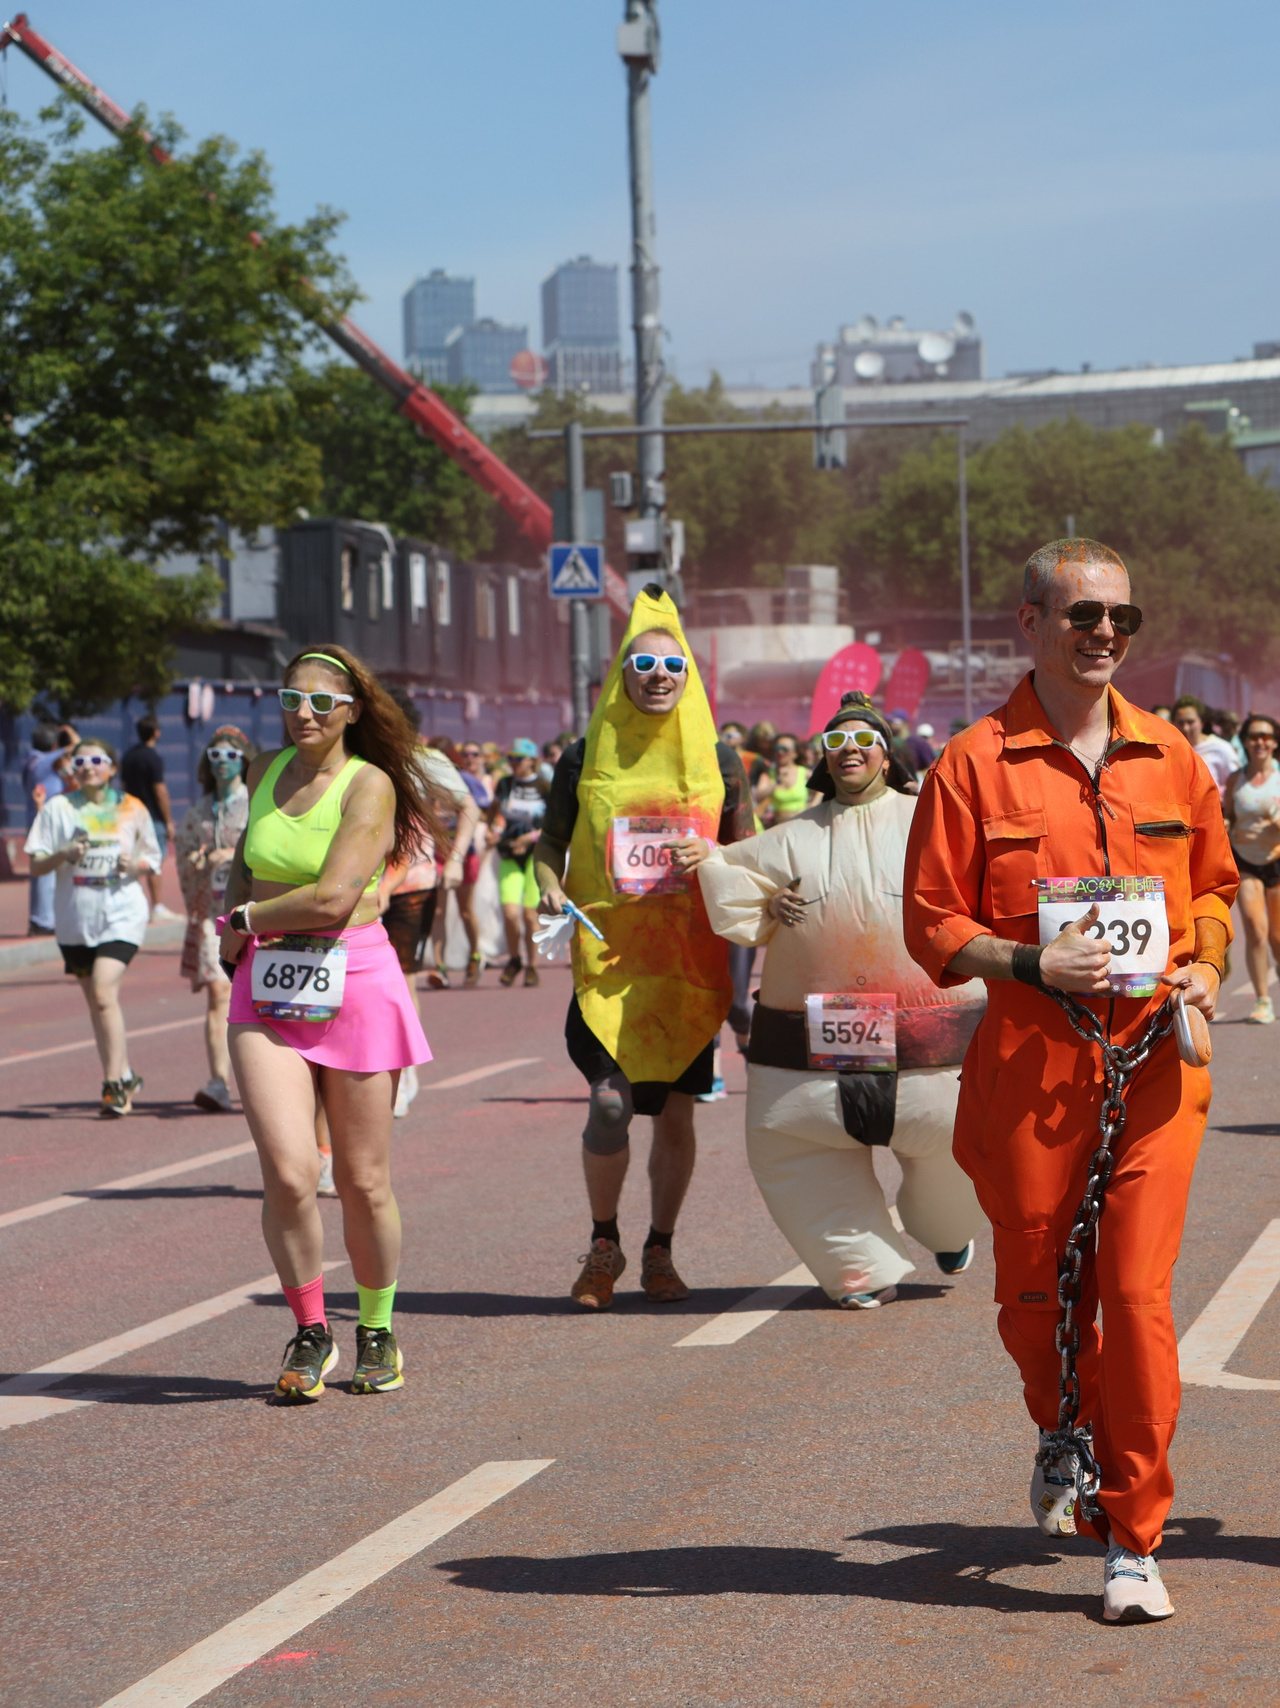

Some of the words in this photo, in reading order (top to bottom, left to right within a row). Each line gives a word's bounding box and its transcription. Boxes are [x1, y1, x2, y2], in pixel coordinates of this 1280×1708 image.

[1115, 893, 1163, 902] 2026
[263, 963, 331, 992] 6878
[822, 1021, 882, 1044] 5594
